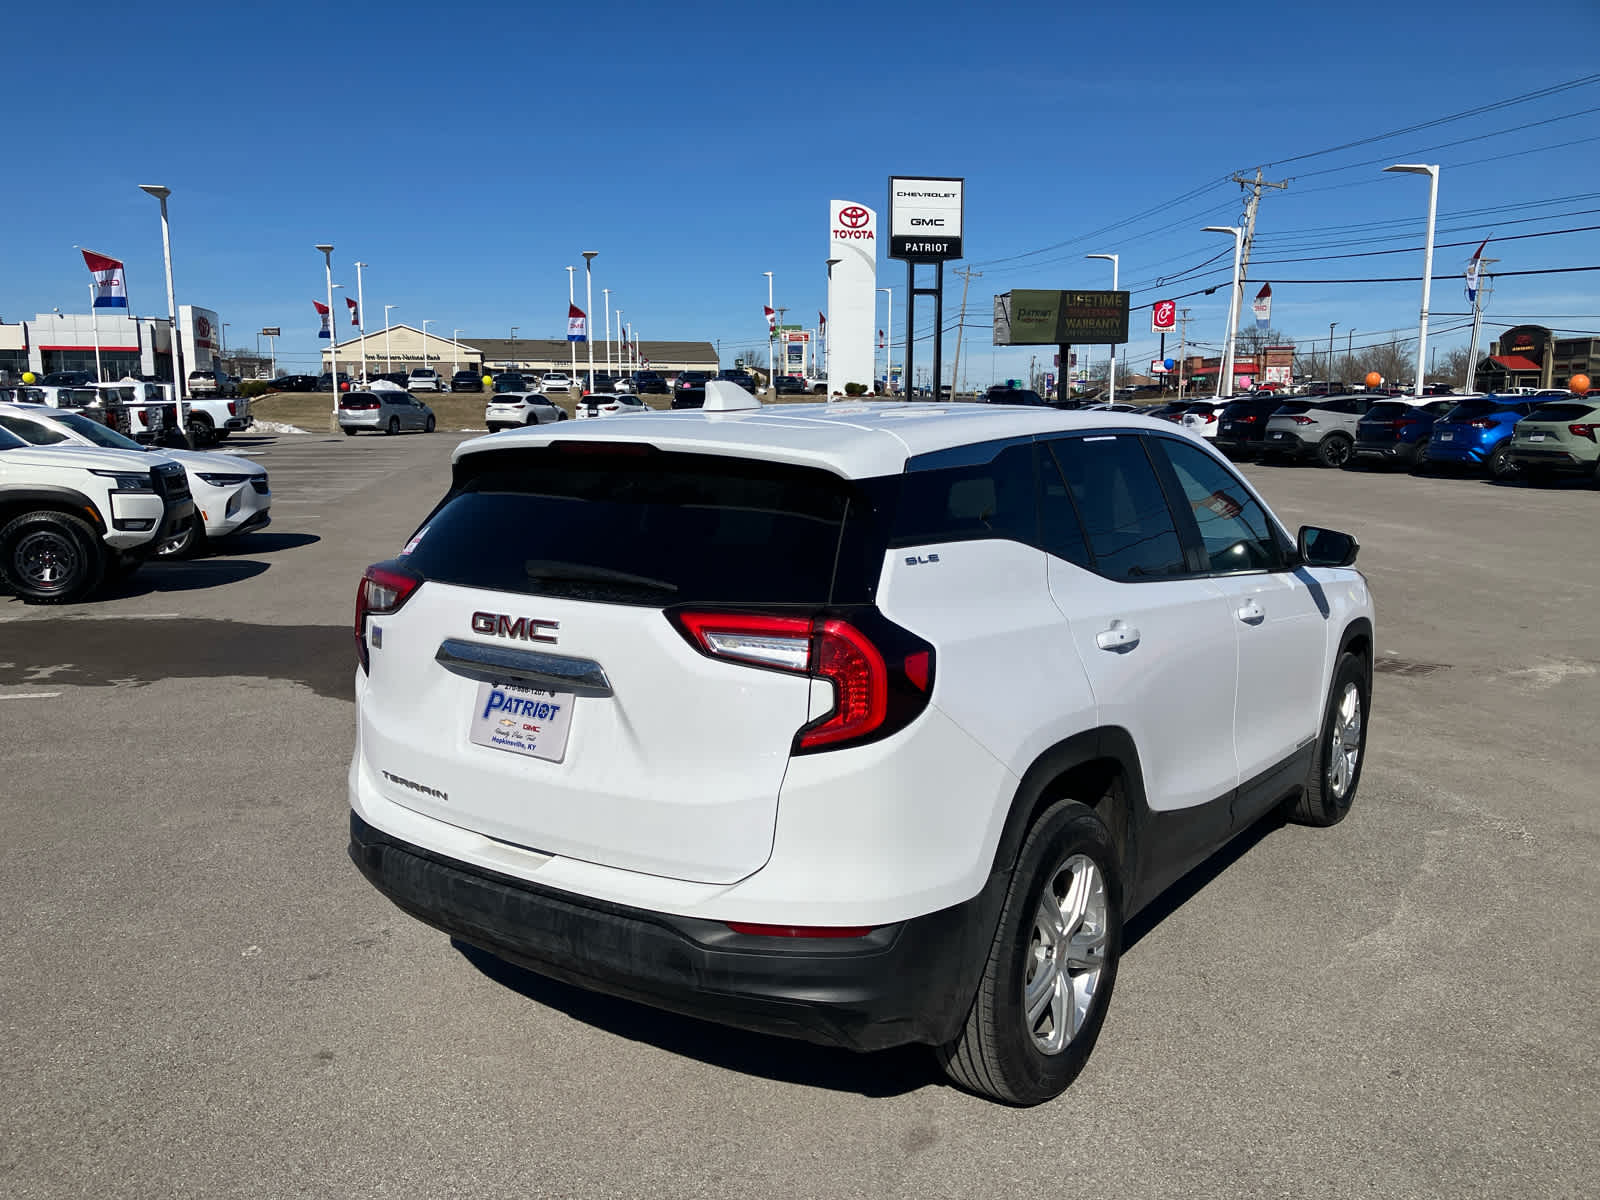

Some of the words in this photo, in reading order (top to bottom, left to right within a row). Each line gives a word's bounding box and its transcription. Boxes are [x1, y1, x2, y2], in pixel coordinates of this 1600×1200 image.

[910, 218, 944, 226] GMC
[833, 230, 874, 239] TOYOTA
[905, 242, 948, 252] PATRIOT
[471, 611, 560, 645] GMC
[482, 690, 560, 721] PATRIOT
[522, 723, 541, 733] GMC
[527, 743, 537, 751] KY
[382, 769, 449, 801] TERRAIN
